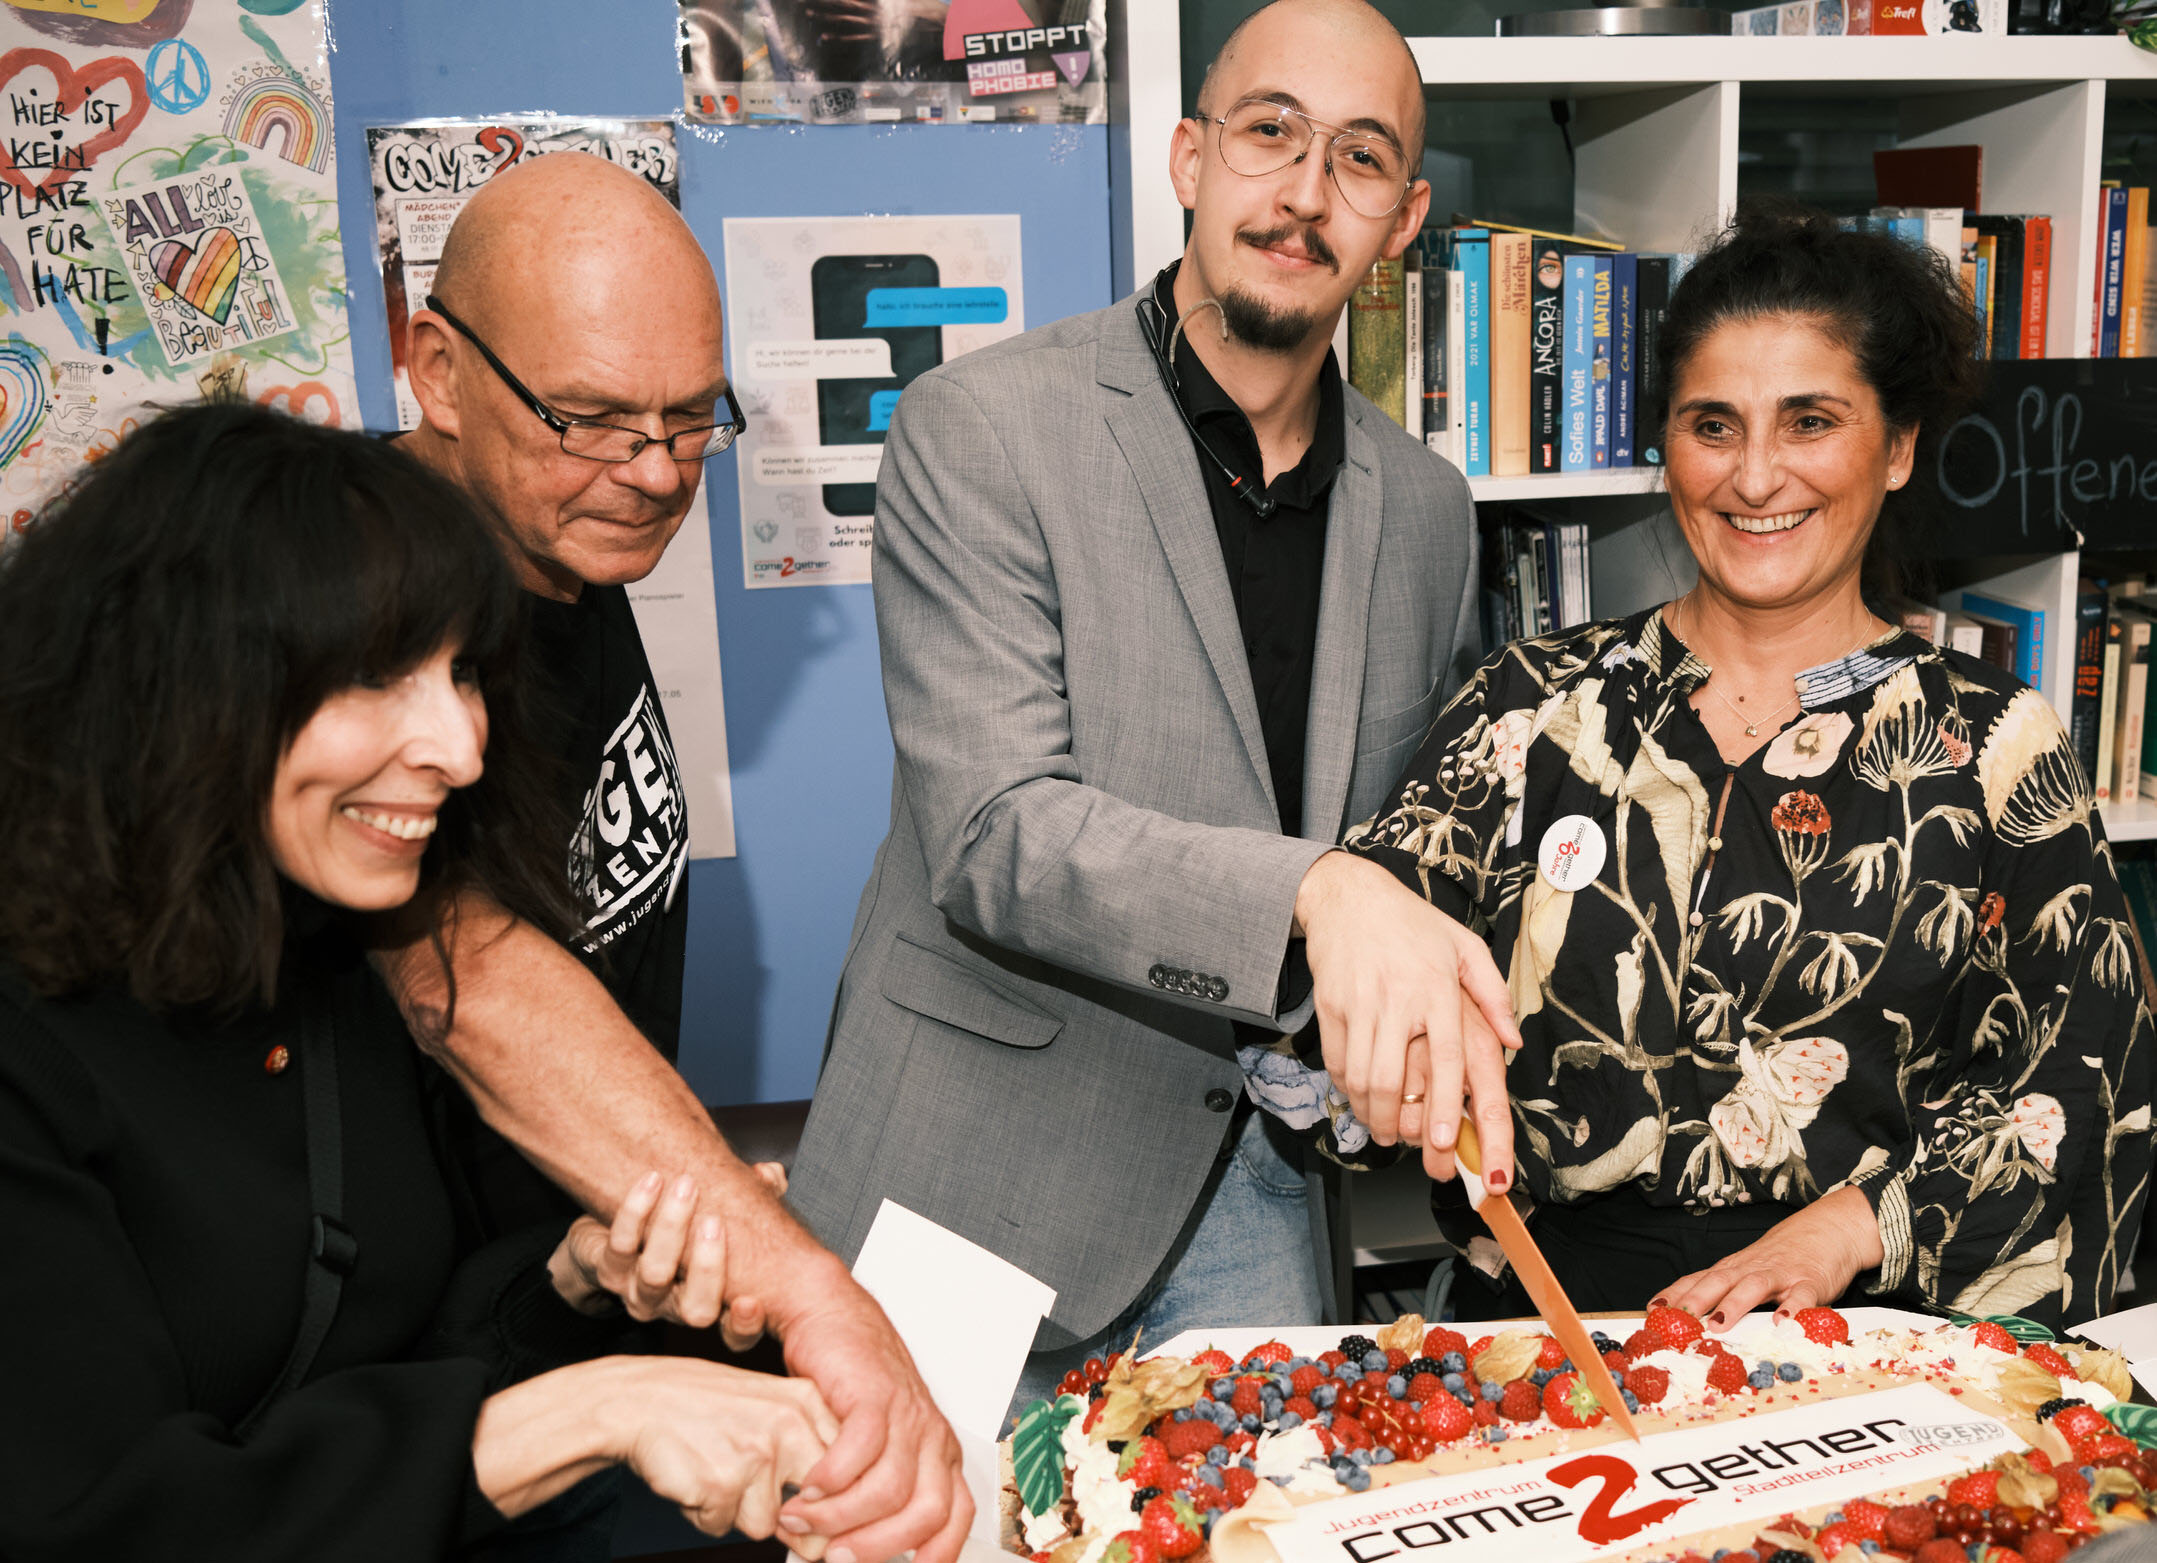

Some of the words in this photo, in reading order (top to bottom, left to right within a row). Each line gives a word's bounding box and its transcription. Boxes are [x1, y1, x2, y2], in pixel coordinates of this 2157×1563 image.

[1894, 6, 1916, 20] Trefl
[965, 24, 1085, 56] STOPPT
[967, 59, 1026, 77] HOMO
[970, 72, 1057, 94] PHOBIE
[11, 88, 69, 126] HIER
[84, 86, 120, 131] IST
[10, 130, 84, 168] KEIN
[0, 180, 91, 218] PLATZ
[125, 185, 204, 243] ALL
[28, 219, 93, 255] FÜR
[410, 223, 453, 233] DIENSTA
[2111, 229, 2122, 257] WER
[32, 260, 129, 306] HATE
[2109, 259, 2120, 284] WIR
[1470, 281, 1479, 317] OLMAK
[1593, 271, 1611, 337] MATILDA
[2106, 286, 2118, 318] SIND
[1470, 319, 1479, 340] VAR
[1470, 343, 1479, 366] 2021
[1569, 369, 1585, 407] Welt
[1619, 380, 1628, 410] ACIMAN
[1569, 411, 1585, 464] Sofies
[1938, 386, 2157, 536] Offene
[829, 540, 854, 548] oder
[583, 857, 681, 953] www.jugend
[1733, 1443, 1942, 1497] Stadtteilzentrum
[1323, 1480, 1542, 1535] Jugendzentrum
